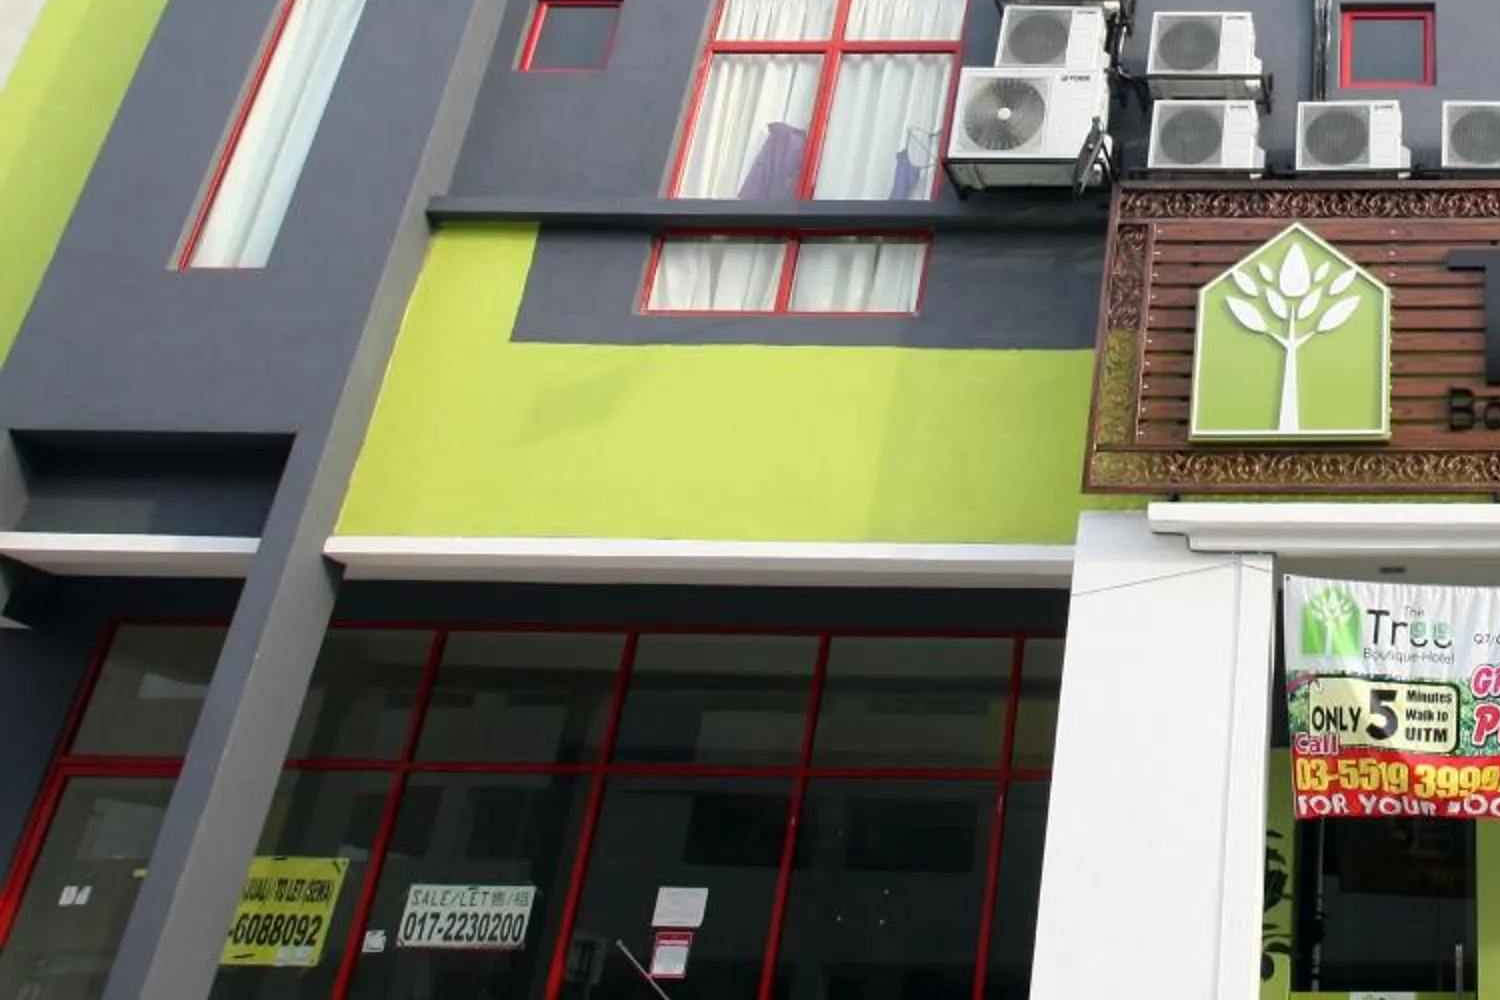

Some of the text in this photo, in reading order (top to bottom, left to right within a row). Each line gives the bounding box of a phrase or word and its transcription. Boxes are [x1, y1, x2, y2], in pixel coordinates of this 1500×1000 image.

[1367, 609, 1452, 649] Tree
[1406, 689, 1453, 704] Minutes
[1311, 689, 1399, 740] ONLY 5
[1405, 708, 1449, 722] Walk to
[1295, 732, 1340, 755] Call
[1295, 757, 1409, 794] 03-5519
[411, 890, 490, 907] SALE/LET
[403, 911, 525, 942] 017-2230200
